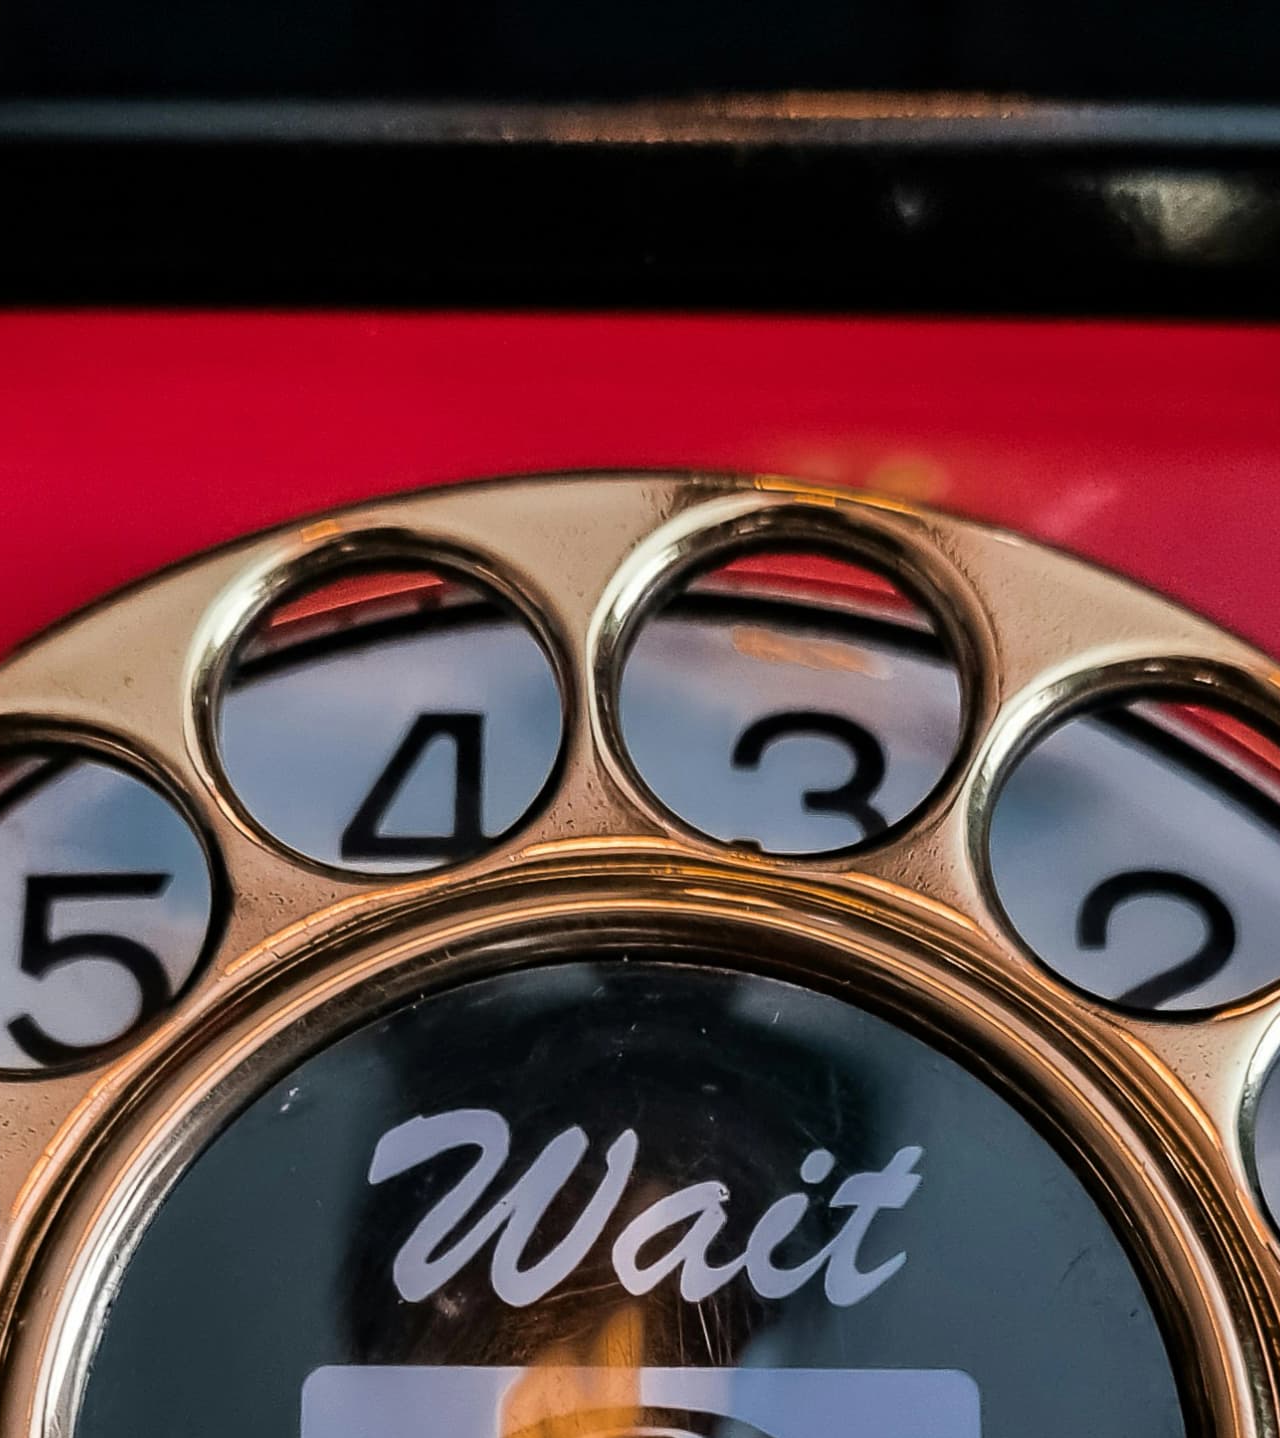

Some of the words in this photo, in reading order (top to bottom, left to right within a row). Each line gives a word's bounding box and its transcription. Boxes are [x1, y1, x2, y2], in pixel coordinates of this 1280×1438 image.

[339, 711, 494, 862] 4
[731, 710, 887, 855] 3
[7, 873, 176, 1067] 5
[1077, 870, 1236, 1010] 2
[368, 1109, 922, 1306] Wait
